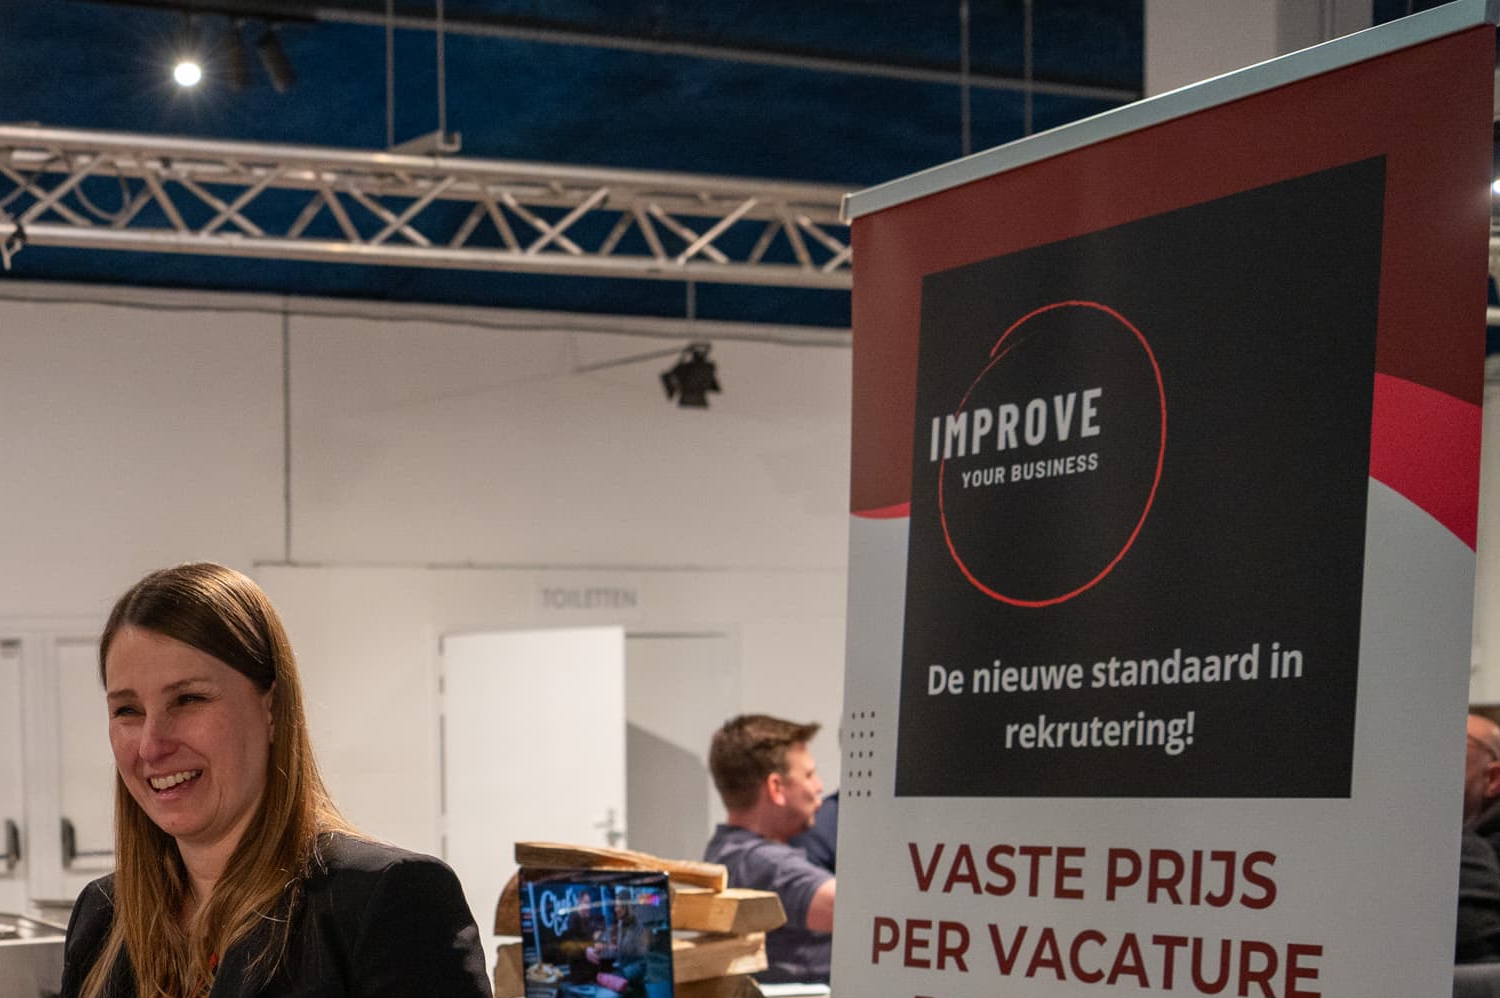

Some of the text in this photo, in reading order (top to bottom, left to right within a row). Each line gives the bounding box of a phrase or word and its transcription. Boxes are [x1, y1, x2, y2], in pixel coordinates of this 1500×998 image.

[930, 387, 1102, 462] IMPROVE
[961, 453, 1099, 488] YOUR BUSINESS
[541, 586, 638, 610] TOILETTEN
[928, 642, 1303, 696] De nieuwe standaard in
[1005, 711, 1196, 756] rekrutering!
[908, 842, 1277, 910] VASTE PRIJS
[871, 916, 970, 973] PER
